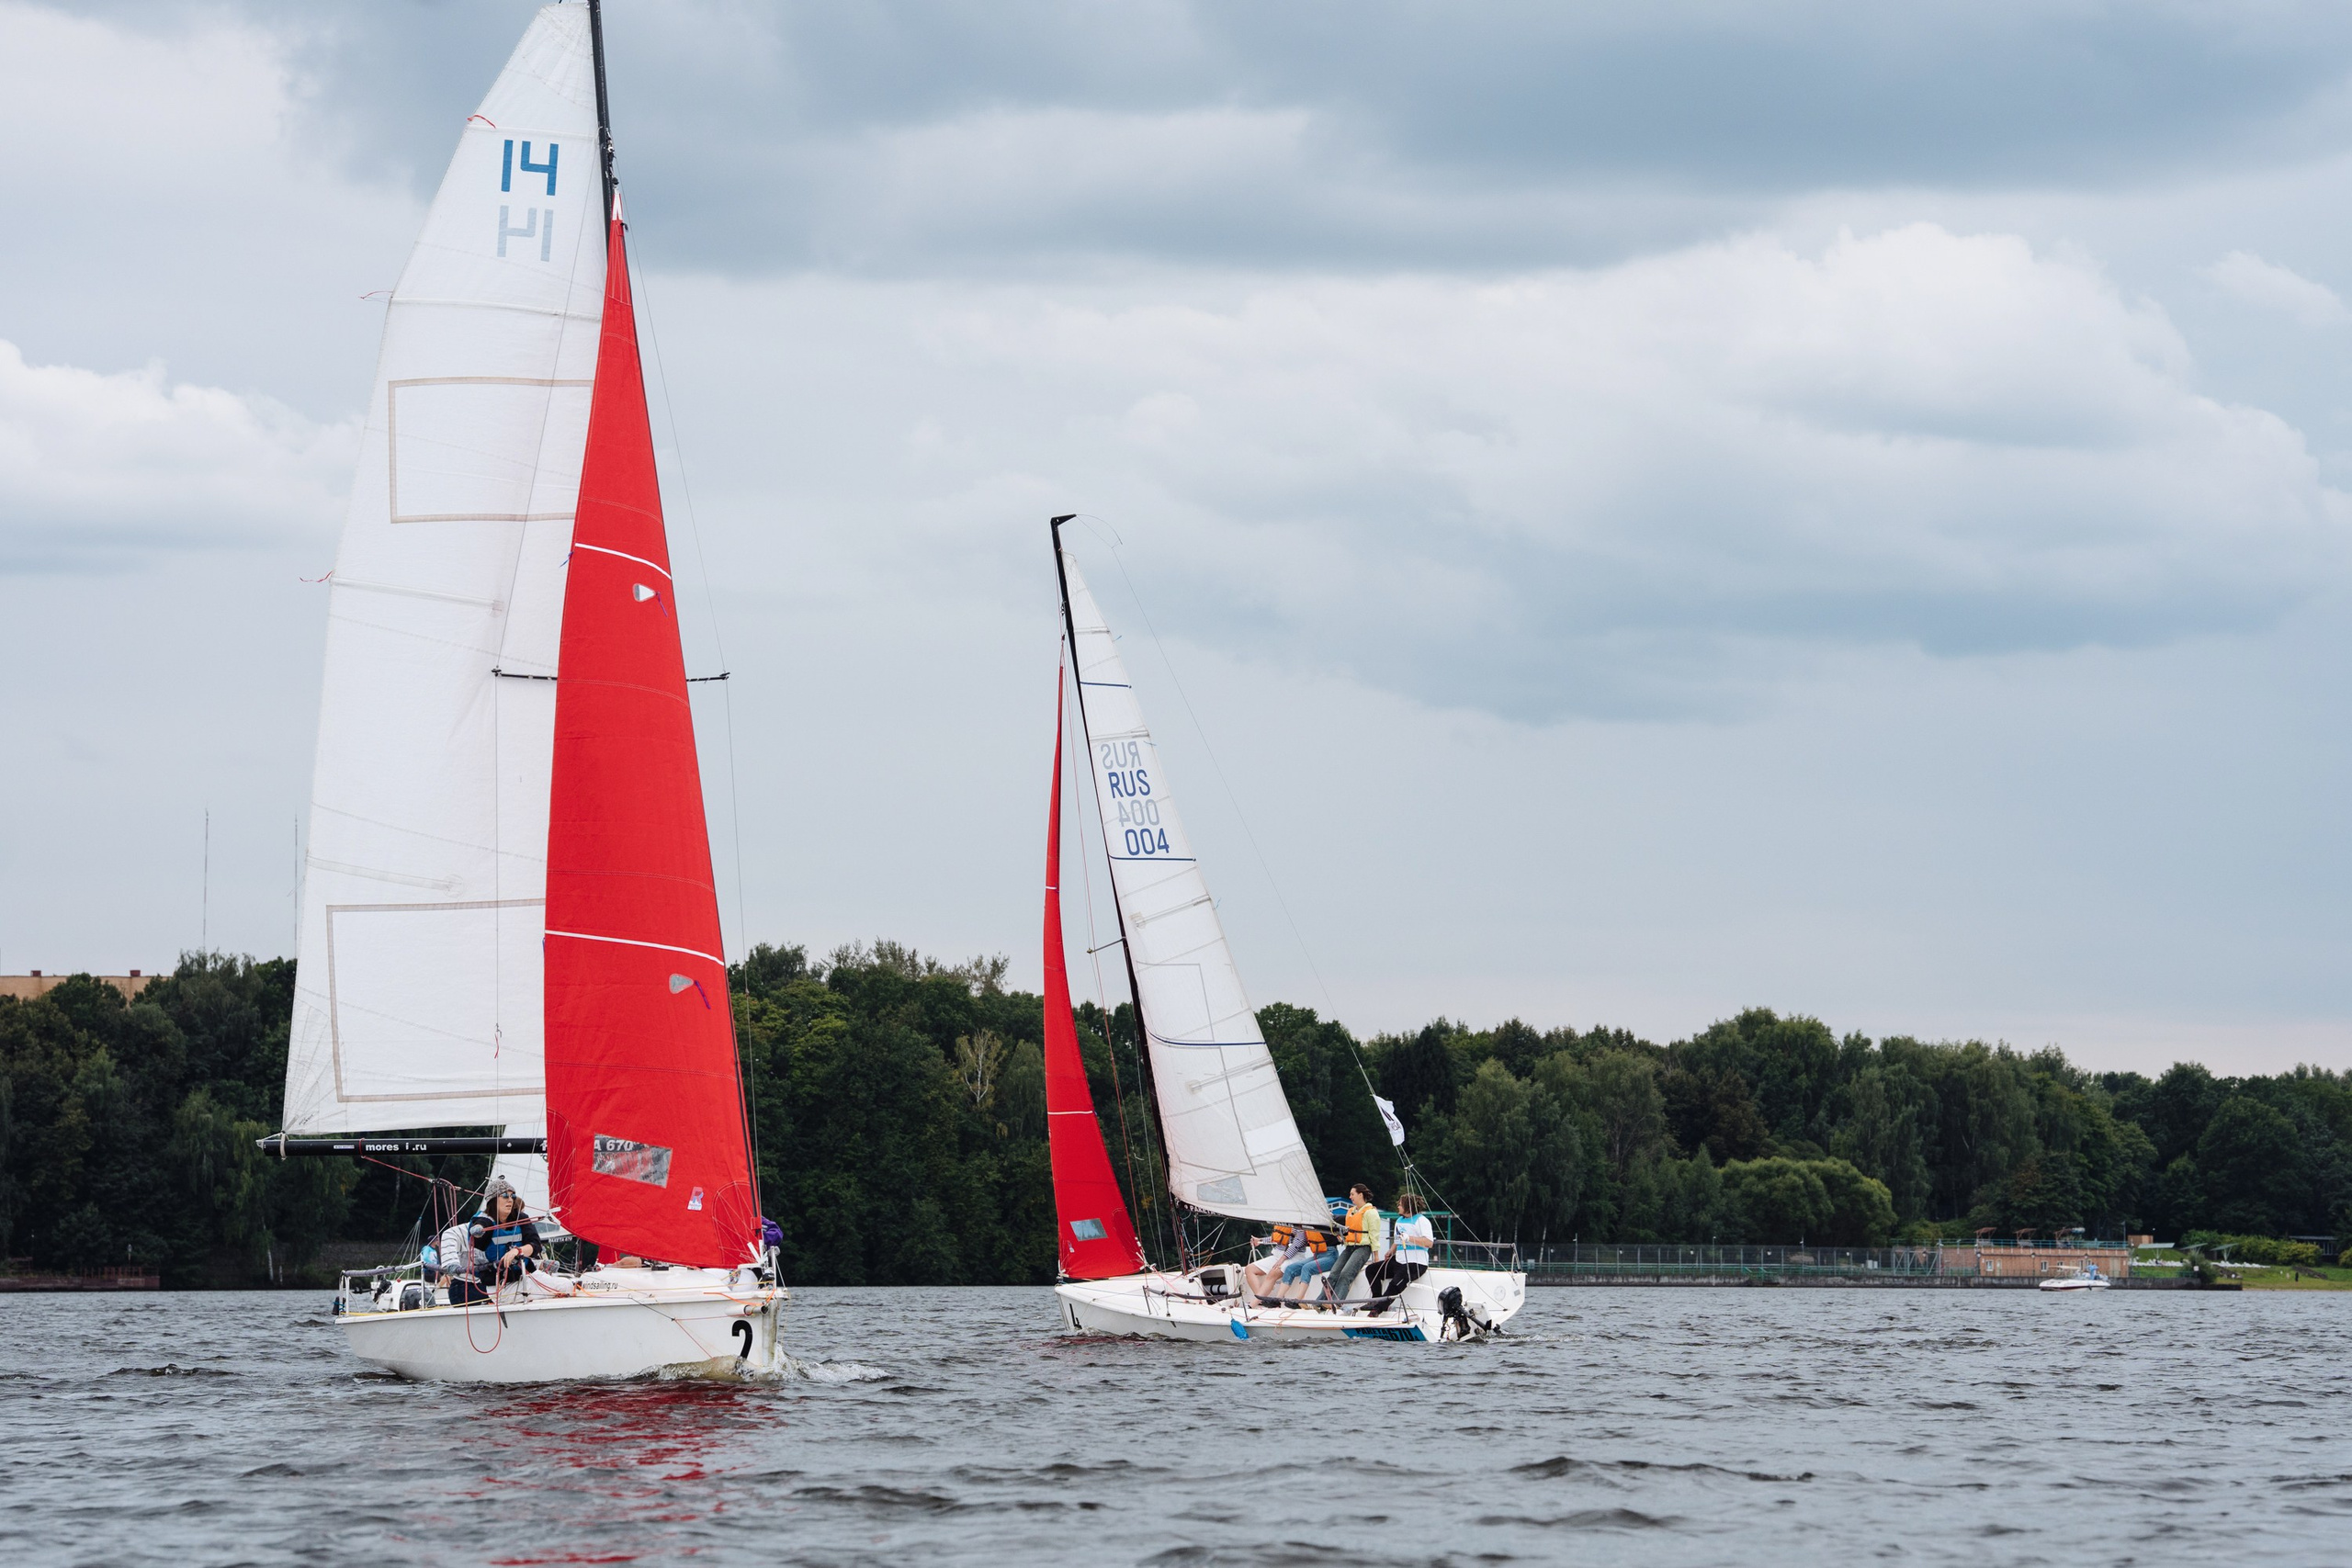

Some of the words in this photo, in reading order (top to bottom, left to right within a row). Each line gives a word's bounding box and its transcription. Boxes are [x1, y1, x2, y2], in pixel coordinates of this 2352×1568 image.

[501, 140, 559, 196] 14
[1108, 769, 1150, 798] RUS
[1125, 828, 1170, 855] 004
[606, 1139, 634, 1151] 670
[1386, 1327, 1416, 1341] 670
